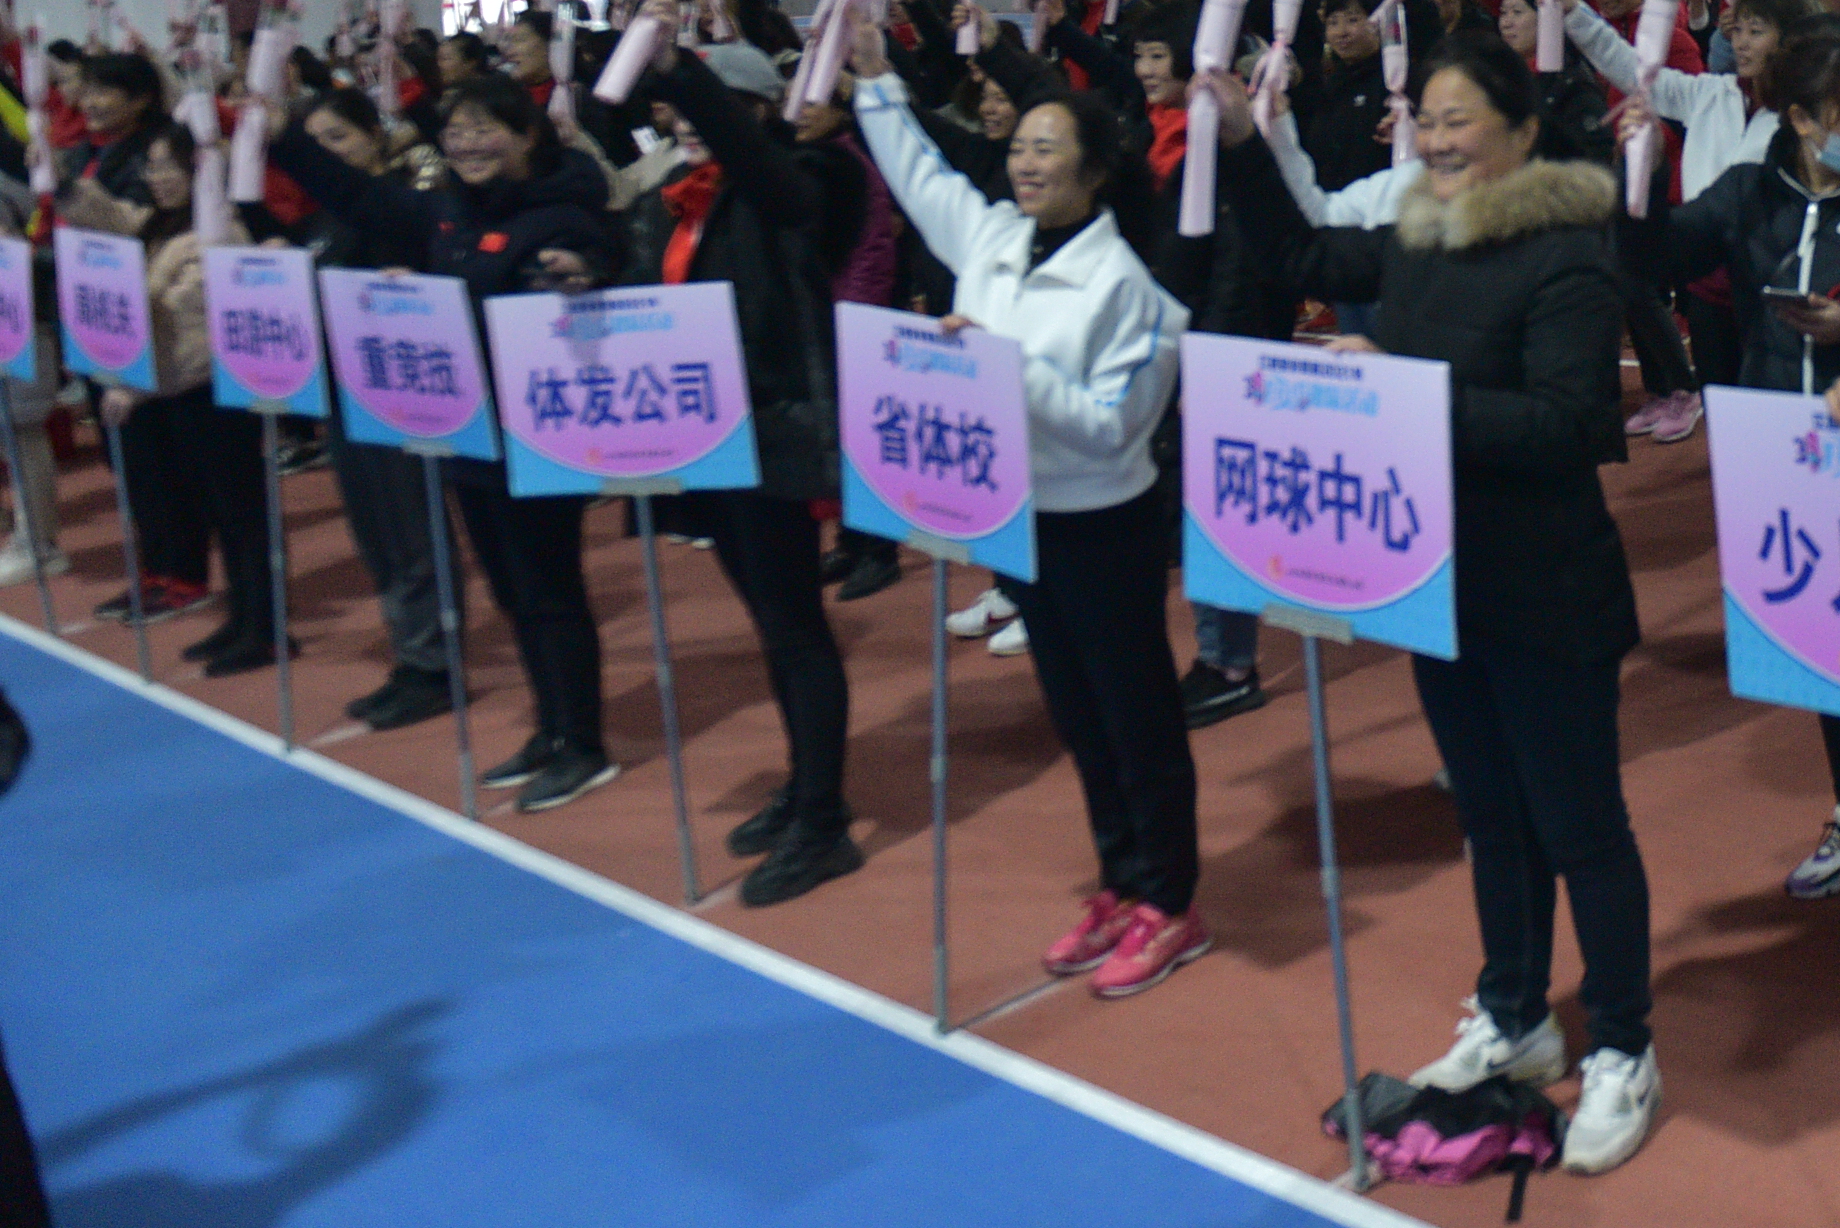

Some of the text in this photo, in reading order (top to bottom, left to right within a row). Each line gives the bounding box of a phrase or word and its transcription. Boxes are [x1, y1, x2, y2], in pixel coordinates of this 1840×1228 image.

[524, 361, 717, 432] 体发公司
[871, 394, 999, 494] 省体校
[1213, 436, 1421, 553] 网球中心
